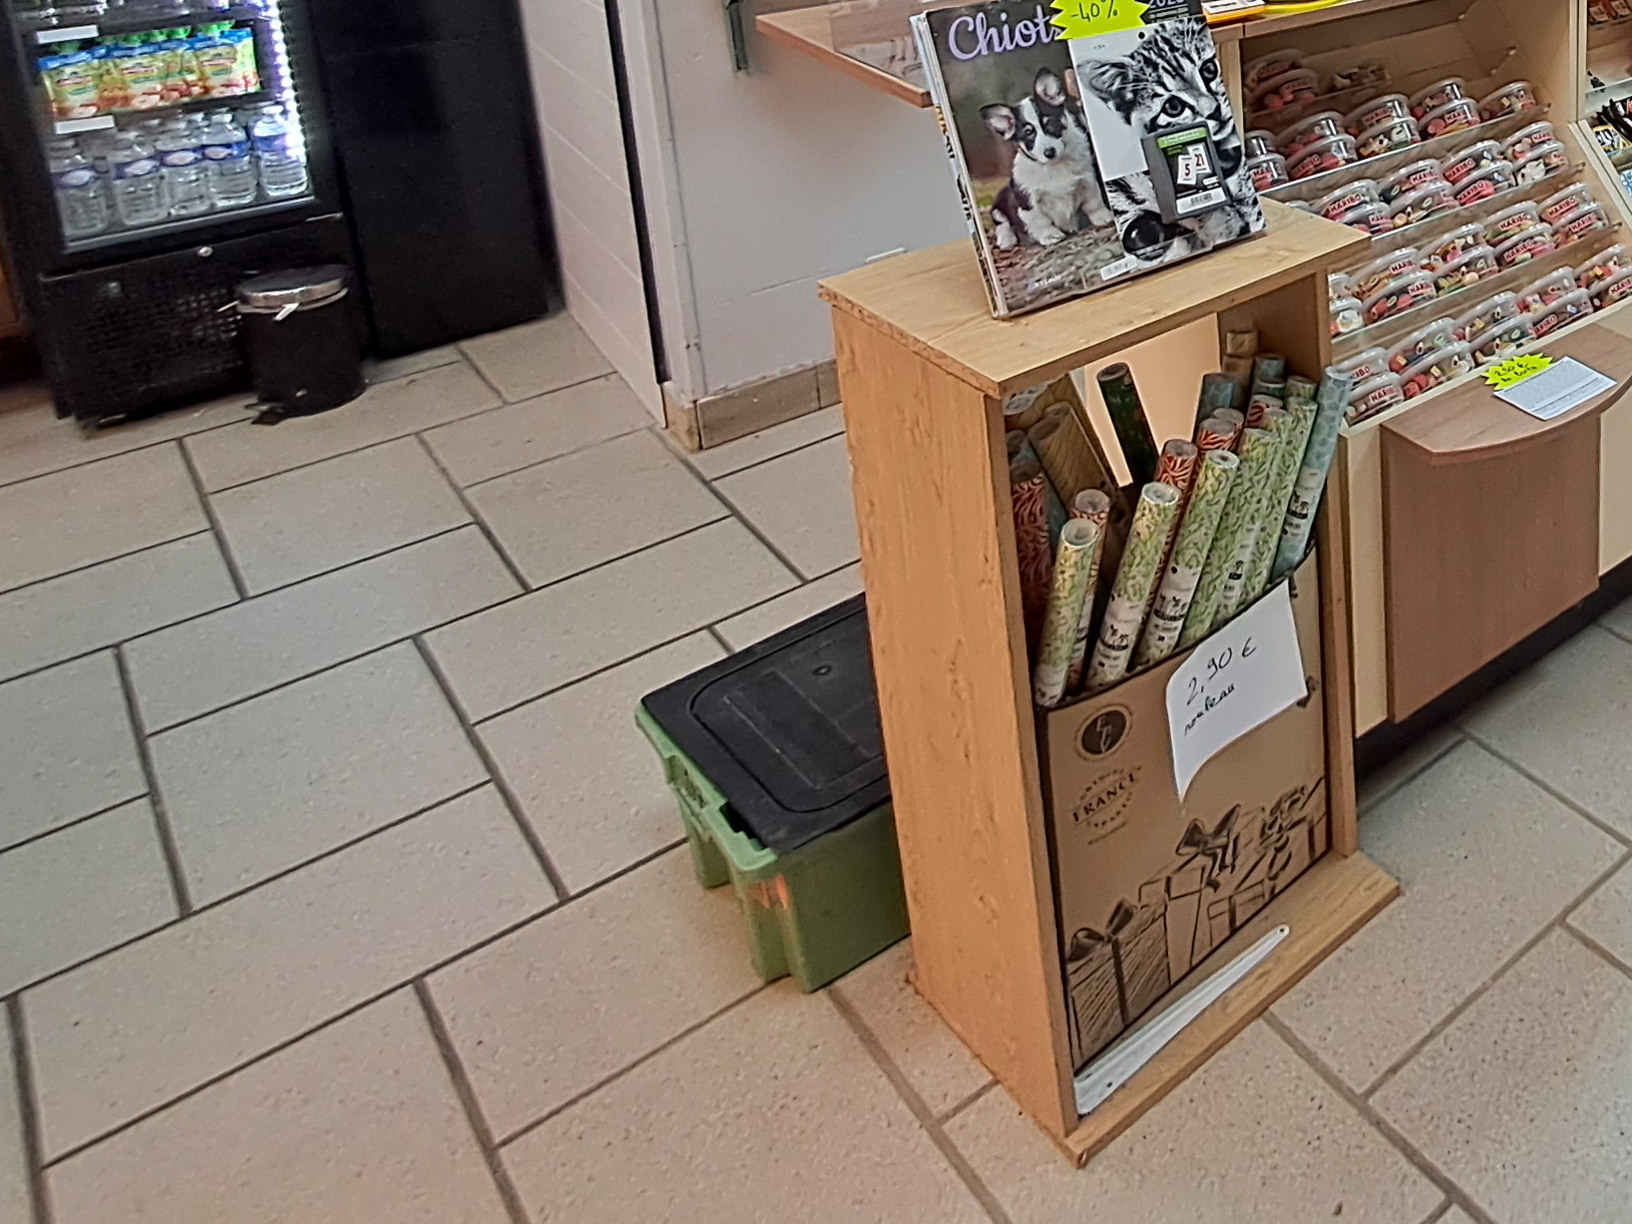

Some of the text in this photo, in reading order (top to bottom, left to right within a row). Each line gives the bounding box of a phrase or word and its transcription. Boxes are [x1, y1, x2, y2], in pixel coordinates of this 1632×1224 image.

[1184, 164, 1191, 176] 5
[1194, 153, 1205, 168] 21
[1330, 194, 1362, 213] HARIBO
[1549, 196, 1577, 216] HARIBO
[1186, 637, 1258, 706] 2,90 €
[1183, 683, 1236, 736] rouleau
[1072, 772, 1135, 823] FRANCE
